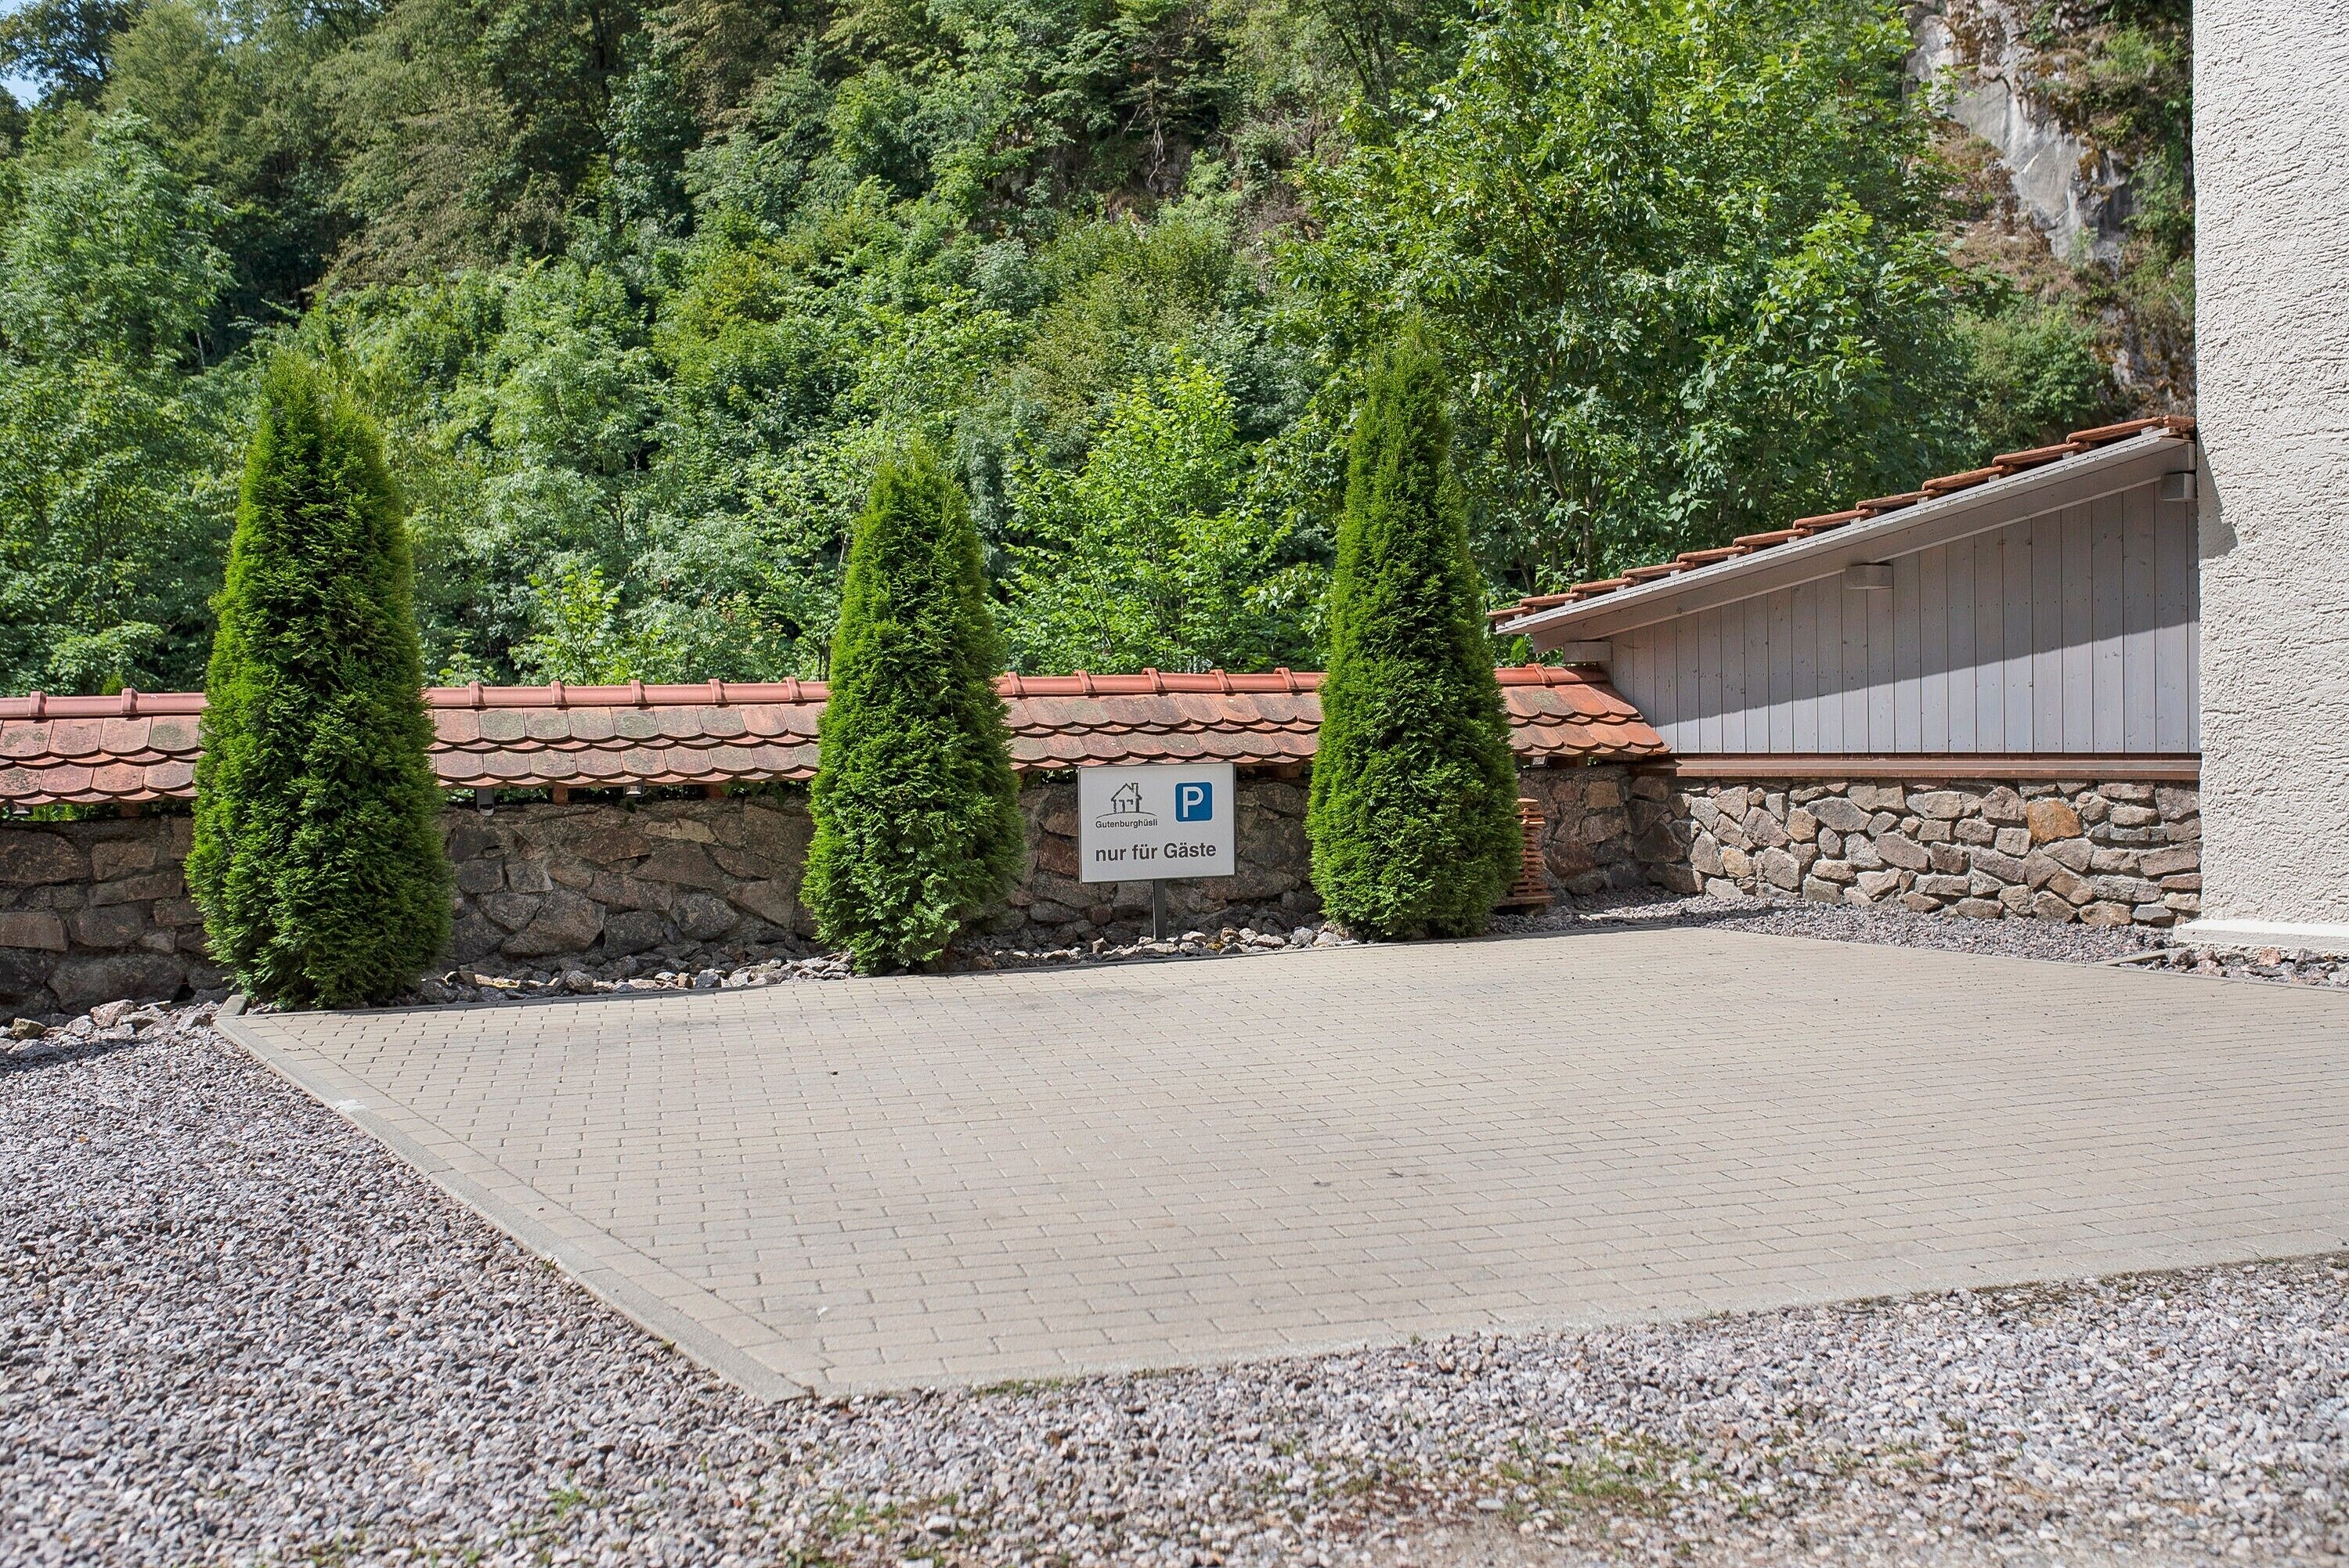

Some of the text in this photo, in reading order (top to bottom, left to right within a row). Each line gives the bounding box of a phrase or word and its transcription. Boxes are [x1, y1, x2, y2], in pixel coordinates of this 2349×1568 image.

[1182, 786, 1204, 818] P
[1095, 818, 1158, 829] Gutenburghüsli
[1095, 842, 1217, 862] nur für Gäste
